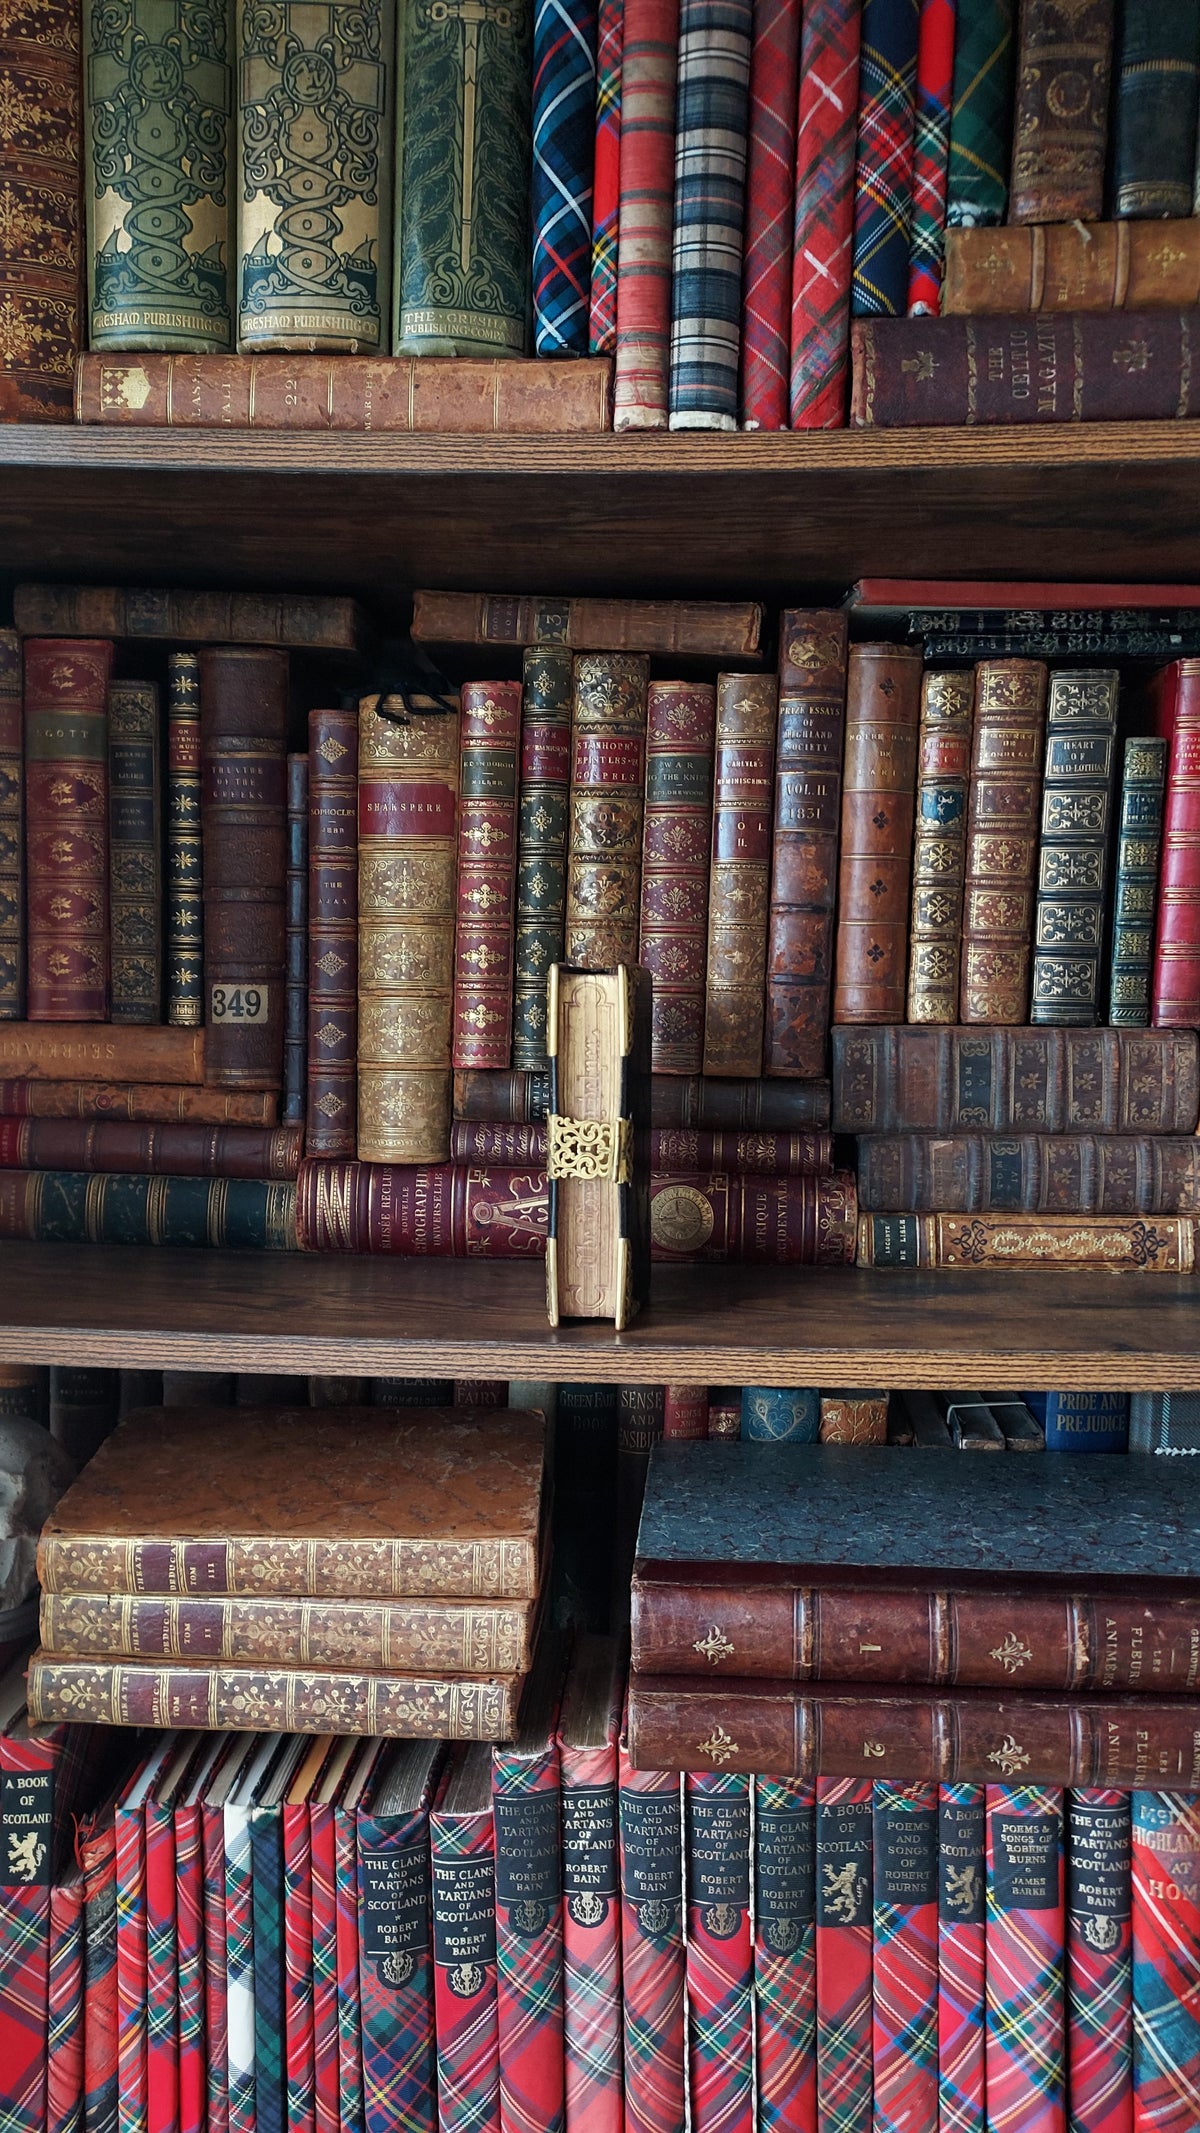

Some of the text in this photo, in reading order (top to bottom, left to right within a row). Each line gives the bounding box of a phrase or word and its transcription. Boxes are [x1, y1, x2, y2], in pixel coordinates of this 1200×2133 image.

[94, 312, 212, 332] GRESHAM PUBLISHING
[405, 311, 435, 324] THE
[241, 315, 290, 331] GRESHAM
[294, 316, 361, 333] PUBLISHING
[989, 347, 1003, 381] THE
[1011, 330, 1030, 399] CELTIC
[285, 379, 297, 405] 22
[546, 615, 561, 625] 3
[780, 706, 840, 716] PRIZE ESSAYS
[802, 718, 815, 727] OF
[534, 730, 558, 739] LIFE
[784, 730, 833, 740] HIGHLAND
[849, 733, 885, 741] NOTRE
[577, 741, 639, 751] STANHOPE'S
[785, 742, 829, 752] SOCIETY
[1063, 740, 1095, 750] HEART
[577, 756, 627, 765] EPISTLES
[1070, 752, 1085, 761] OF
[463, 761, 514, 769] EDINBURGH
[664, 761, 694, 769] WAR
[726, 757, 764, 768] CARLYLE'S
[211, 766, 264, 776] THEATRE
[217, 778, 256, 786] OF THE
[576, 772, 636, 782] GOSPELS
[662, 773, 679, 781] THE
[212, 791, 264, 800] GREEKS
[786, 783, 815, 797] VOL.
[310, 808, 356, 817] SOPHOCLES
[366, 803, 442, 813] SHAKSPERE
[787, 807, 822, 820] 1831
[212, 989, 262, 1018] 349
[965, 1066, 973, 1099] TOM
[532, 1075, 541, 1117] FAMILY
[472, 1122, 492, 1164] Postage
[380, 1167, 393, 1249] ÉLISÉE RECLUS
[401, 1186, 410, 1234] NOUVELLE
[432, 1173, 443, 1247] UNIVERSELLE
[755, 1193, 768, 1251] AFRIQUE
[899, 1219, 907, 1260] DE LISLE
[457, 1387, 500, 1404] FAIRY
[621, 1390, 662, 1411] SENSE
[1058, 1391, 1126, 1410] PRIDE AND
[629, 1414, 655, 1426] AND
[1056, 1413, 1126, 1433] PREJUDICE
[189, 1566, 197, 1586] TOM
[207, 1562, 215, 1579] III
[184, 1622, 192, 1644] TOM
[204, 1628, 212, 1639] II
[859, 1643, 882, 1652] 1
[1127, 1626, 1142, 1685] FLEURS
[1152, 1649, 1161, 1674] LES
[863, 1742, 885, 1758] 2
[1132, 1731, 1149, 1788] FLEURS
[1157, 1750, 1168, 1774] LES
[5, 1777, 48, 1789] A BOOK
[20, 1796, 35, 1806] OF
[577, 1796, 615, 1809] CLANS
[498, 1803, 560, 1816] THE CLANS
[622, 1800, 681, 1815] THE CLANS
[691, 1805, 713, 1817] THE
[820, 1804, 872, 1818] A BOOK
[3, 1813, 52, 1824] SCOTLAND
[641, 1816, 663, 1824] AND
[943, 1809, 953, 1820] A
[886, 1821, 930, 1830] POEMS
[1070, 1813, 1092, 1826] THE
[1095, 1815, 1130, 1828] CLANS
[502, 1824, 557, 1837] TARTANS
[625, 1822, 679, 1837] TARTANS
[838, 1823, 856, 1833] OF
[1002, 1824, 1039, 1834] POEMS
[578, 1830, 592, 1839] OF
[694, 1828, 749, 1840] TARTANS
[896, 1835, 921, 1844] AND
[958, 1829, 973, 1839] OF
[1001, 1834, 1052, 1843] SONGS OF
[1090, 1830, 1112, 1838] AND
[523, 1838, 535, 1846] OF
[645, 1838, 659, 1846] OF
[715, 1842, 728, 1850] OF
[1071, 1834, 1128, 1850] TARTANS
[500, 1845, 560, 1858] SCOTLAND
[625, 1843, 681, 1857] SCOTLAND
[887, 1846, 929, 1855] SONGS
[1006, 1844, 1049, 1853] ROBERT
[777, 1856, 791, 1864] OF
[1008, 1854, 1046, 1864] BURNS
[1094, 1851, 1108, 1859] OF
[365, 1853, 427, 1870] THE CLANS
[900, 1859, 916, 1867] OF
[1070, 1855, 1130, 1871] SCOTLAND
[1171, 1860, 1193, 1873] AT
[434, 1866, 494, 1880] THE CLANS
[565, 1863, 608, 1873] ROBERT
[387, 1870, 408, 1879] AND
[509, 1872, 549, 1881] ROBERT
[573, 1874, 600, 1883] BAIN
[633, 1870, 674, 1880] ROBERT
[700, 1874, 743, 1884] ROBERT
[885, 1870, 931, 1880] ROBERT
[370, 1874, 424, 1890] TARTANS
[454, 1881, 475, 1889] AND
[640, 1882, 667, 1891] BAIN
[1011, 1877, 1046, 1885] JAMES
[516, 1882, 543, 1892] BAIN
[707, 1885, 736, 1894] BAIN
[887, 1882, 927, 1892] BURNS
[1012, 1886, 1046, 1896] BARKE
[1078, 1883, 1123, 1895] ROBERT
[437, 1887, 492, 1901] TARTANS
[762, 1889, 806, 1899] ROBERT
[367, 1894, 427, 1911] SCOTLAND
[459, 1902, 471, 1910] OF
[769, 1900, 798, 1909] BAIN
[1086, 1895, 1116, 1907] BAIN
[436, 1908, 495, 1922] SCOTLAND
[377, 1920, 419, 1934] ROBERT
[384, 1933, 411, 1944] BAIN
[444, 1933, 487, 1946] ROBERT
[452, 1945, 480, 1956] BAIN
